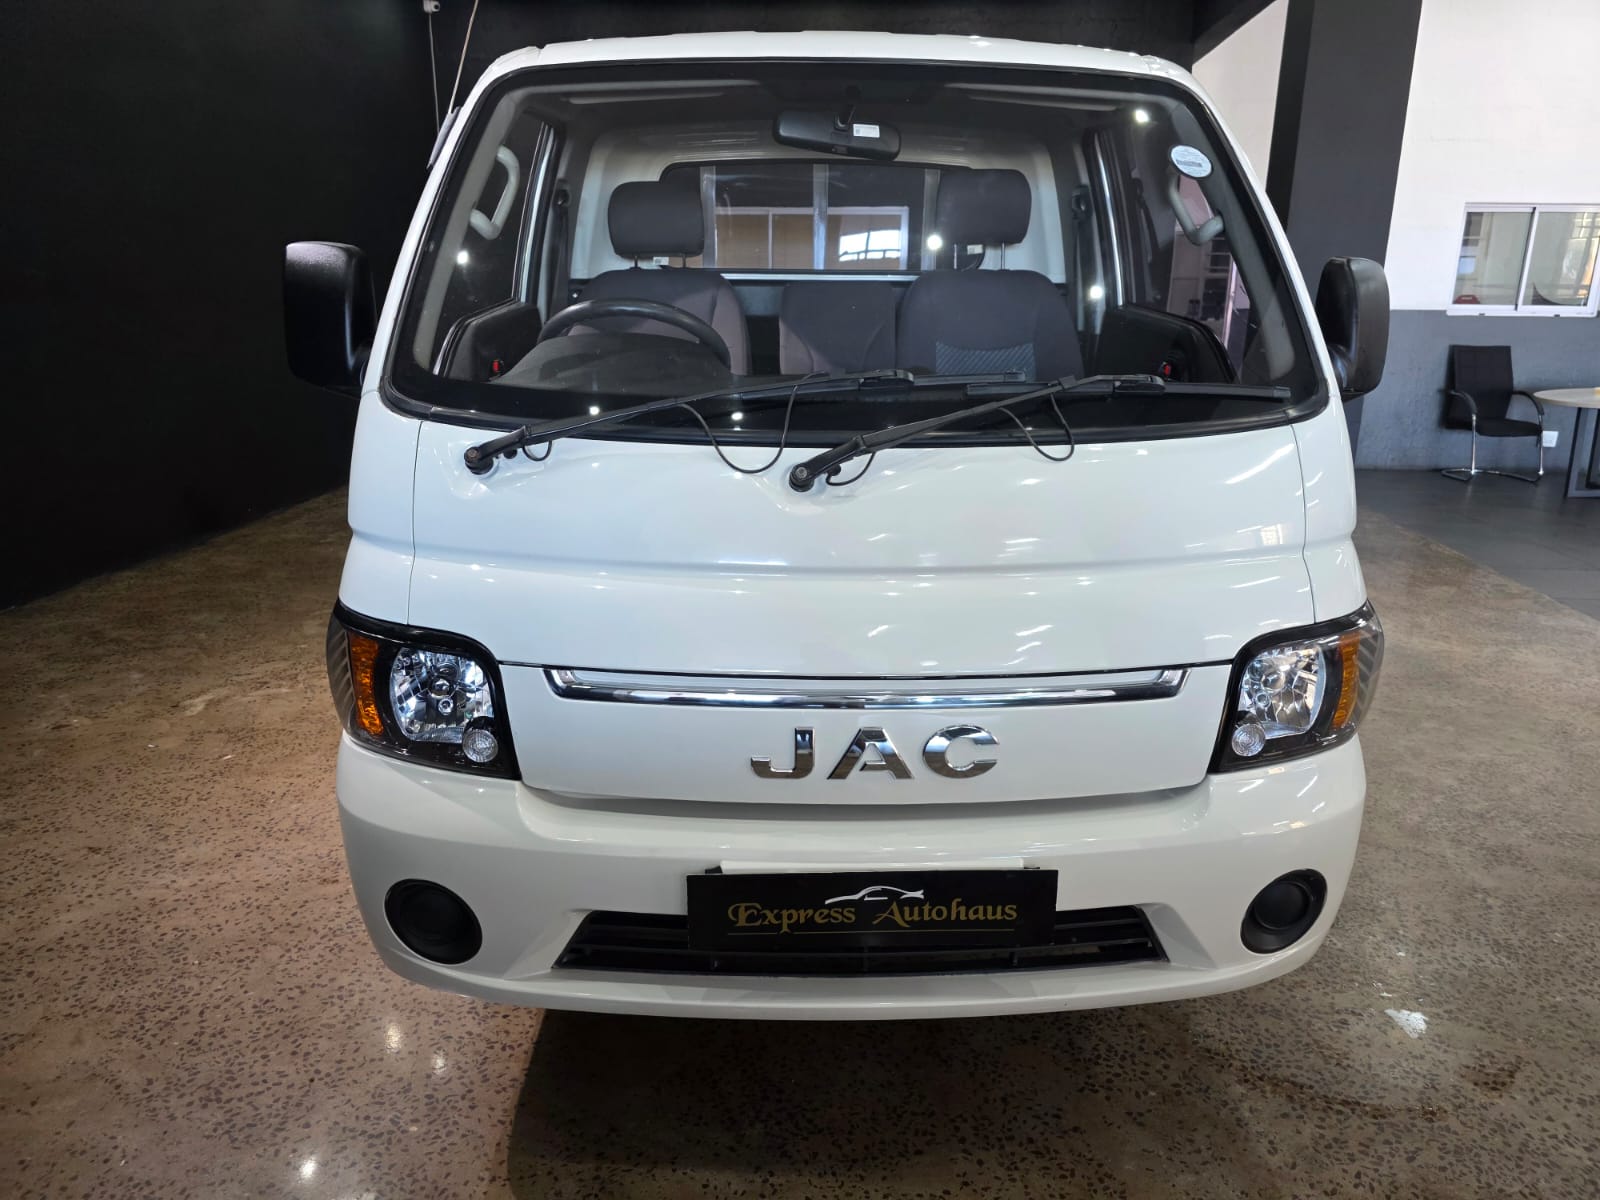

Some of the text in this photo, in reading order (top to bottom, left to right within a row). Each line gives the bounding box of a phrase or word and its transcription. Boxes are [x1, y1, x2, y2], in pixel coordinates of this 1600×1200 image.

[750, 725, 999, 779] JAC
[728, 899, 1018, 933] Express Autohaus
